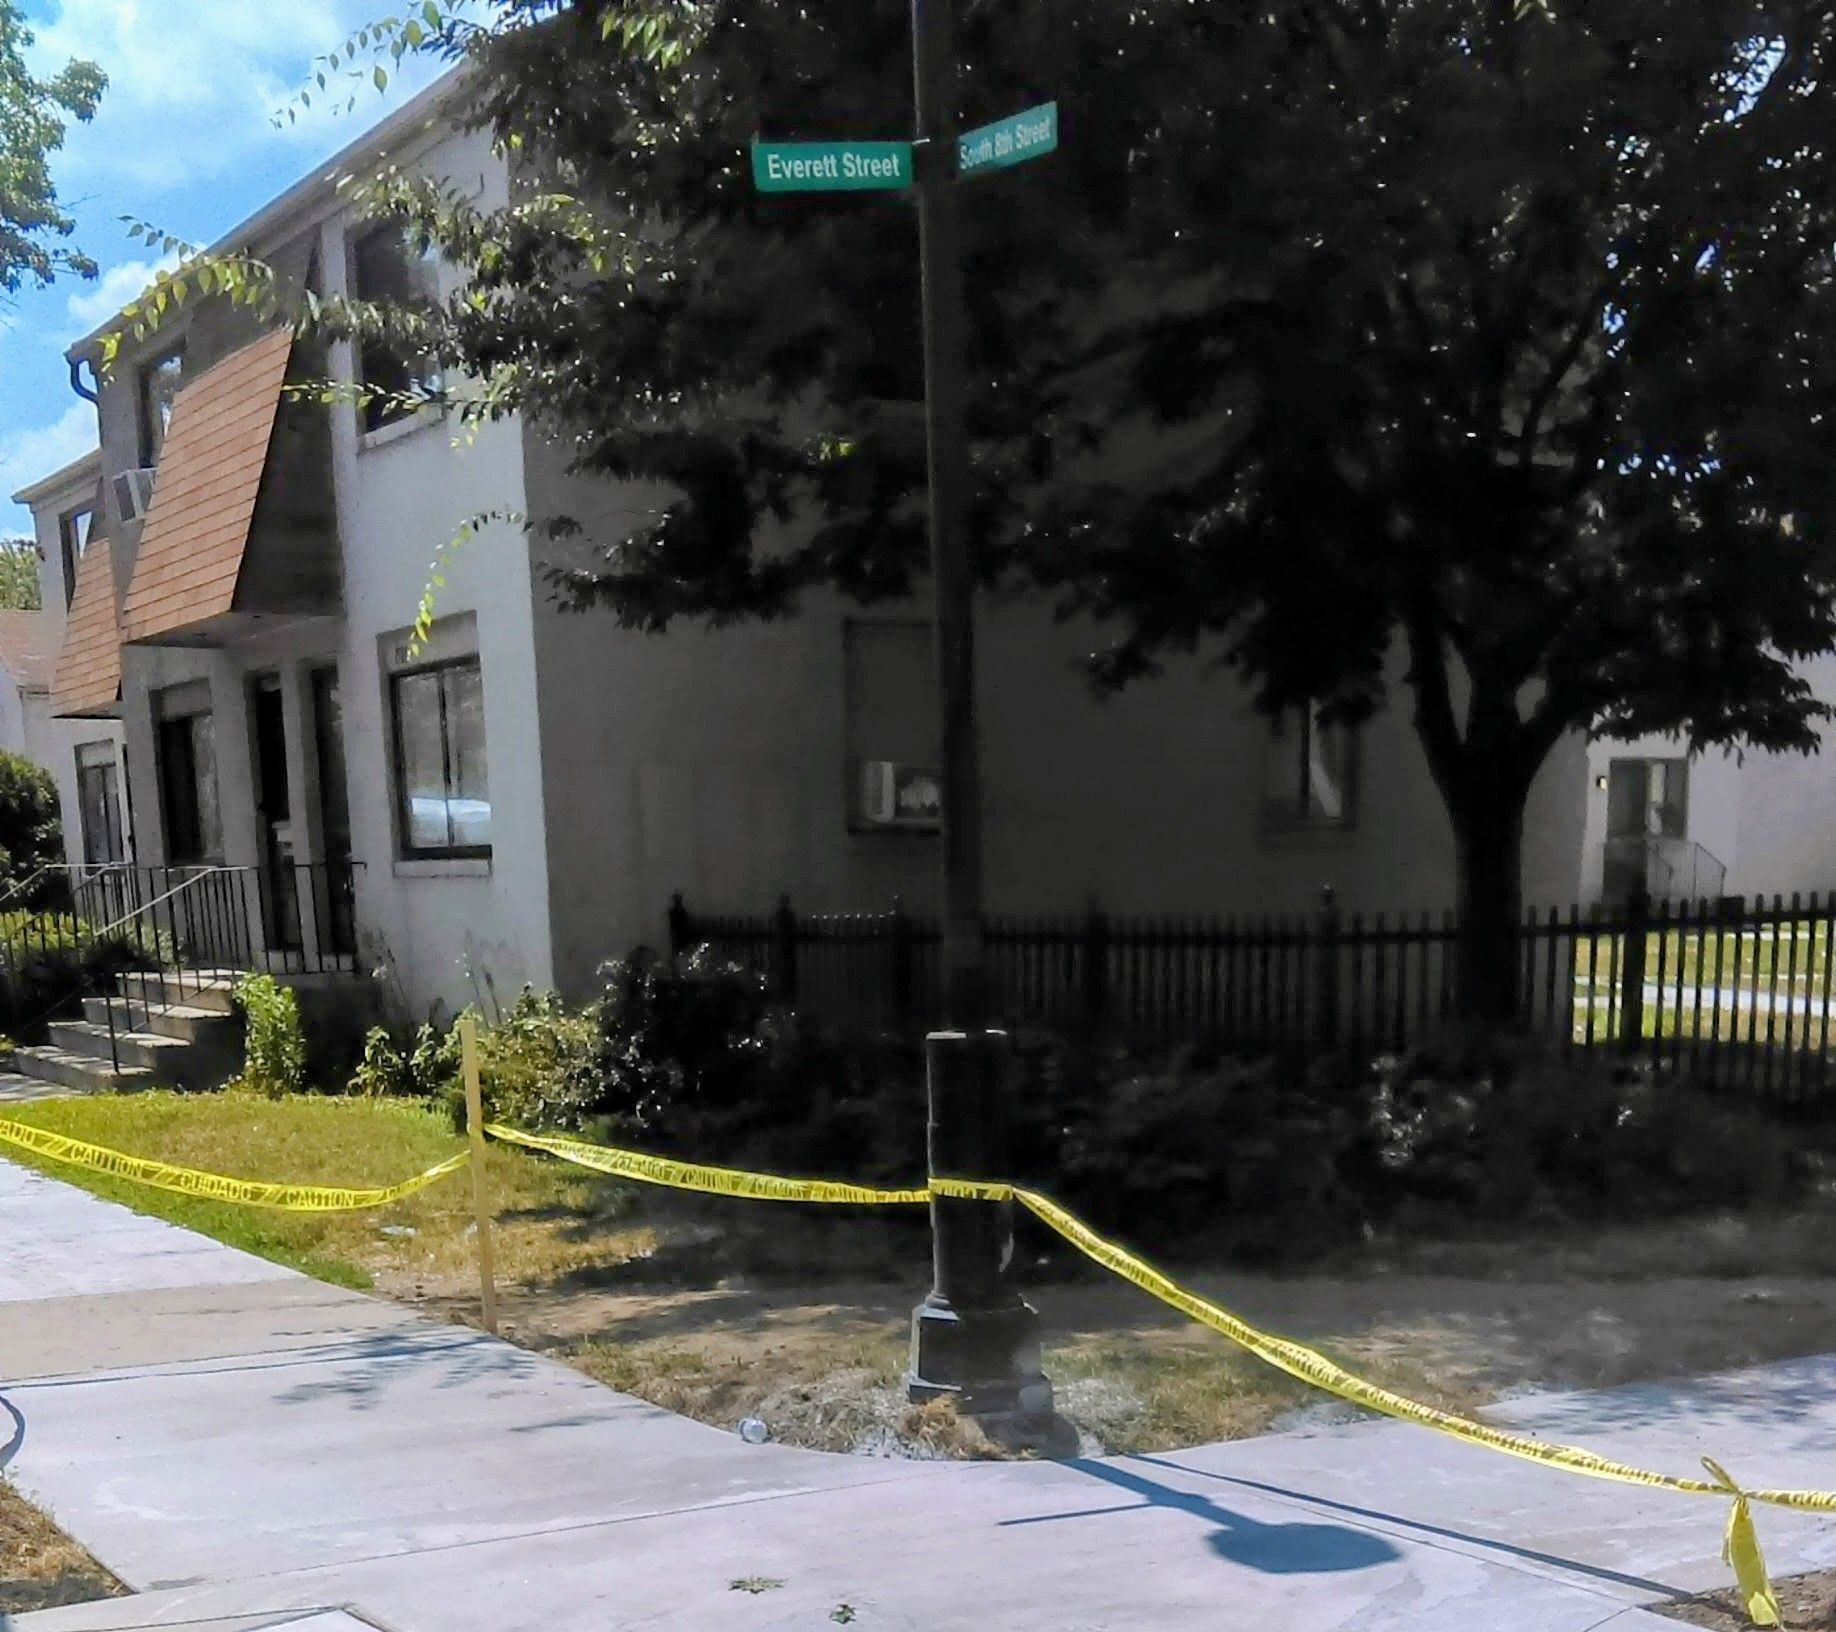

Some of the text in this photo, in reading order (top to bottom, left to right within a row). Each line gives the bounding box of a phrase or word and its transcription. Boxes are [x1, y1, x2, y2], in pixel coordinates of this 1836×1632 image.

[767, 152, 901, 180] Everett Street
[960, 143, 991, 169] South
[1015, 116, 1050, 149] Street
[71, 1143, 143, 1179] CAUTION
[180, 1172, 252, 1201] CUIDADO
[285, 1189, 355, 1208] CAUTION
